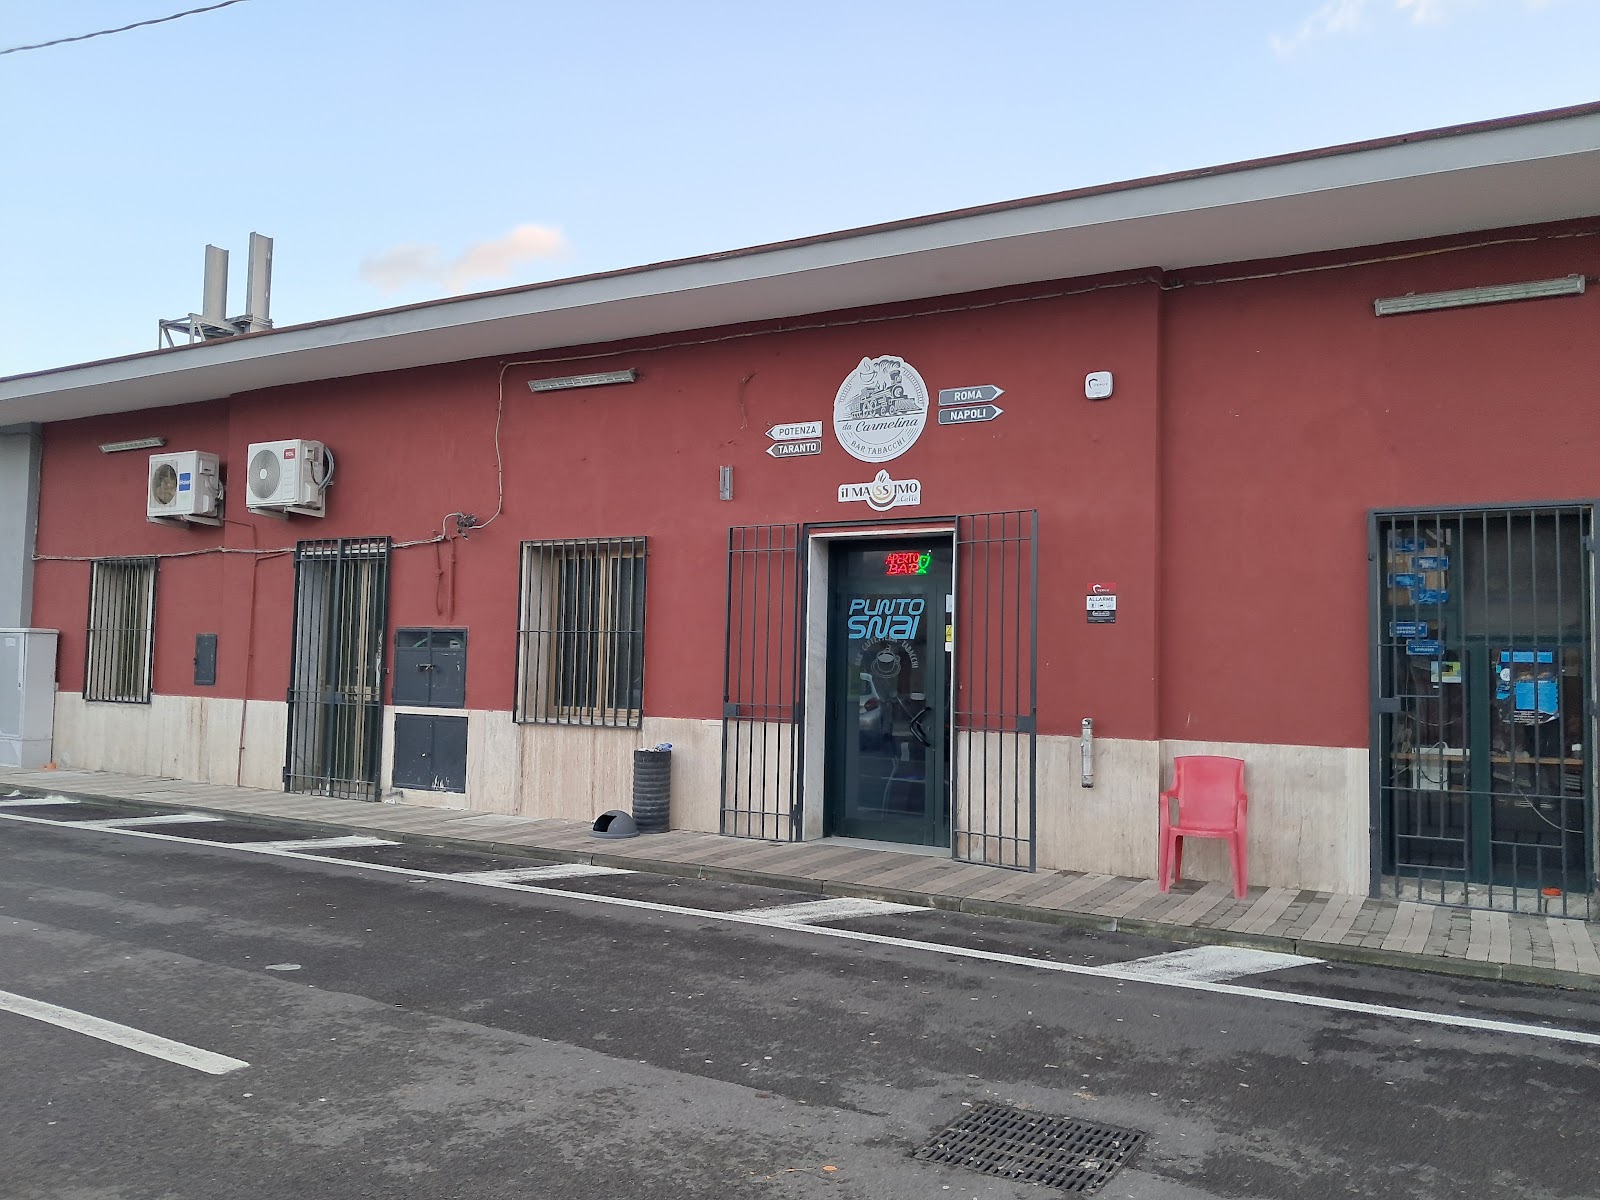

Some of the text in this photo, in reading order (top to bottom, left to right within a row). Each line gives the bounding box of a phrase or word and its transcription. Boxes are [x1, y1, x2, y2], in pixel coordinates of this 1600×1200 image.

[954, 390, 983, 401] ROMA
[950, 408, 986, 421] NAPOLI
[779, 425, 817, 437] POTENZA
[842, 418, 918, 432] da Carmelina
[778, 442, 817, 454] TARANTO
[850, 437, 905, 454] BAR TABACCHI
[852, 483, 917, 498] MASSIMO
[885, 552, 920, 565] APERTO
[886, 563, 919, 575] BAR
[848, 598, 925, 616] PUNTO
